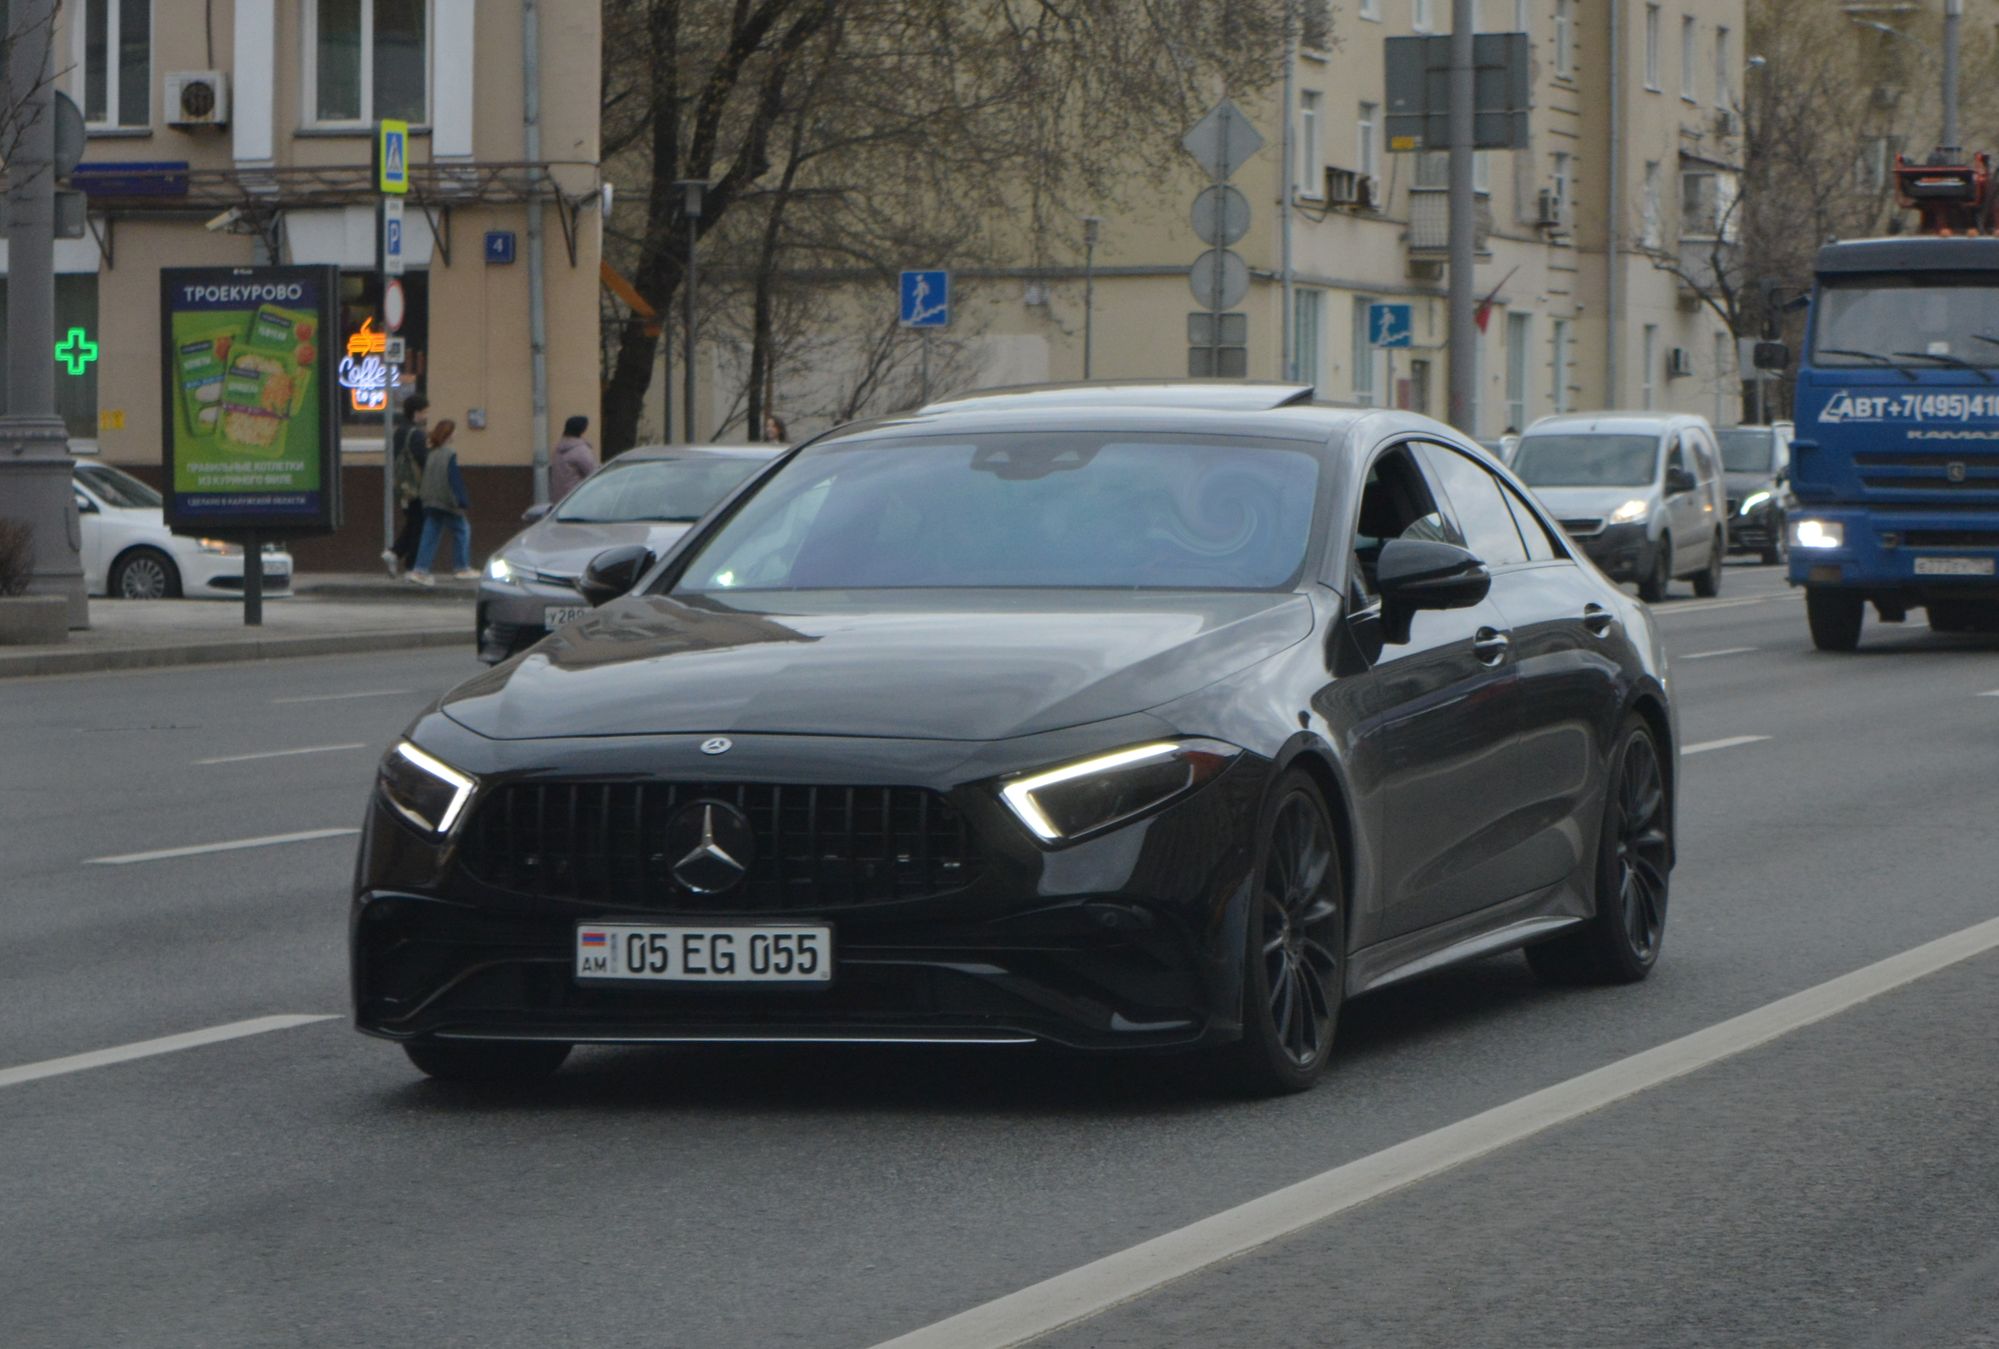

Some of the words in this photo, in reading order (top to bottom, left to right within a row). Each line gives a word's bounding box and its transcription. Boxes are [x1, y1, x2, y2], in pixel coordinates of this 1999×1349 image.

[492, 237, 504, 254] 4
[184, 283, 303, 302] ТРОЕКУРОВО
[338, 356, 401, 389] Coffee
[582, 957, 607, 973] AM
[627, 933, 668, 974] 05
[682, 933, 736, 975] EG
[749, 933, 818, 975] 055
